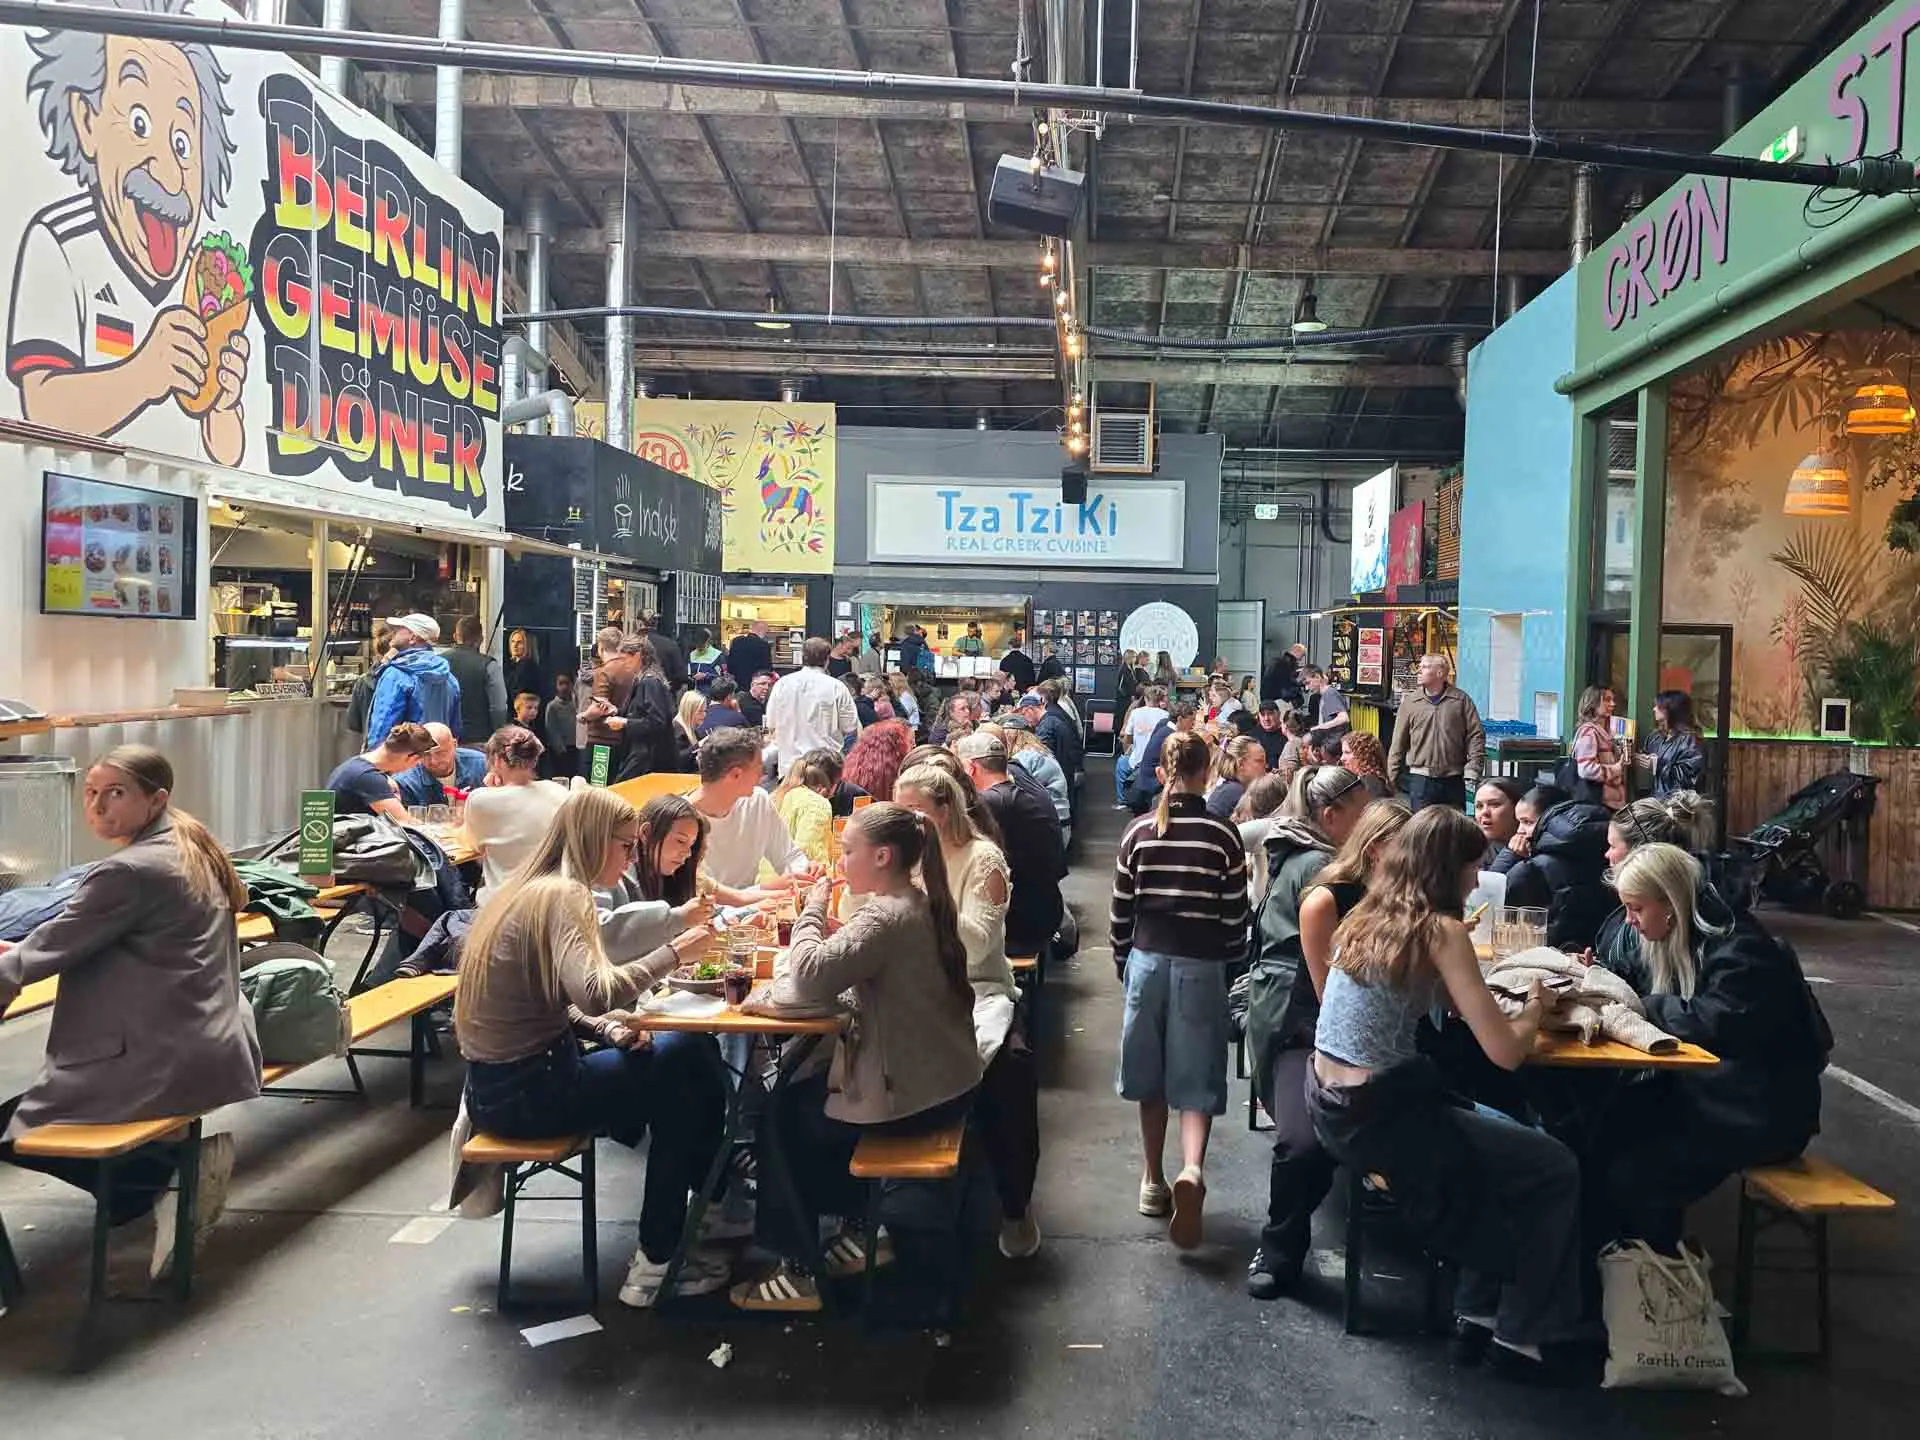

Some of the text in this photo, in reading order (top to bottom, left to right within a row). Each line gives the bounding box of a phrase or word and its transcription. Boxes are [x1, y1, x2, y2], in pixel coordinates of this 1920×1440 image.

[268, 99, 496, 327] BERLIN
[1602, 176, 1731, 331] GRØN
[262, 233, 499, 412] GEMÜSE
[274, 345, 485, 498] DÖNER
[639, 491, 677, 546] Indisk
[937, 490, 1118, 537] Tza Tzi Ki
[946, 537, 990, 551] REAL
[993, 537, 1043, 553] GREEK
